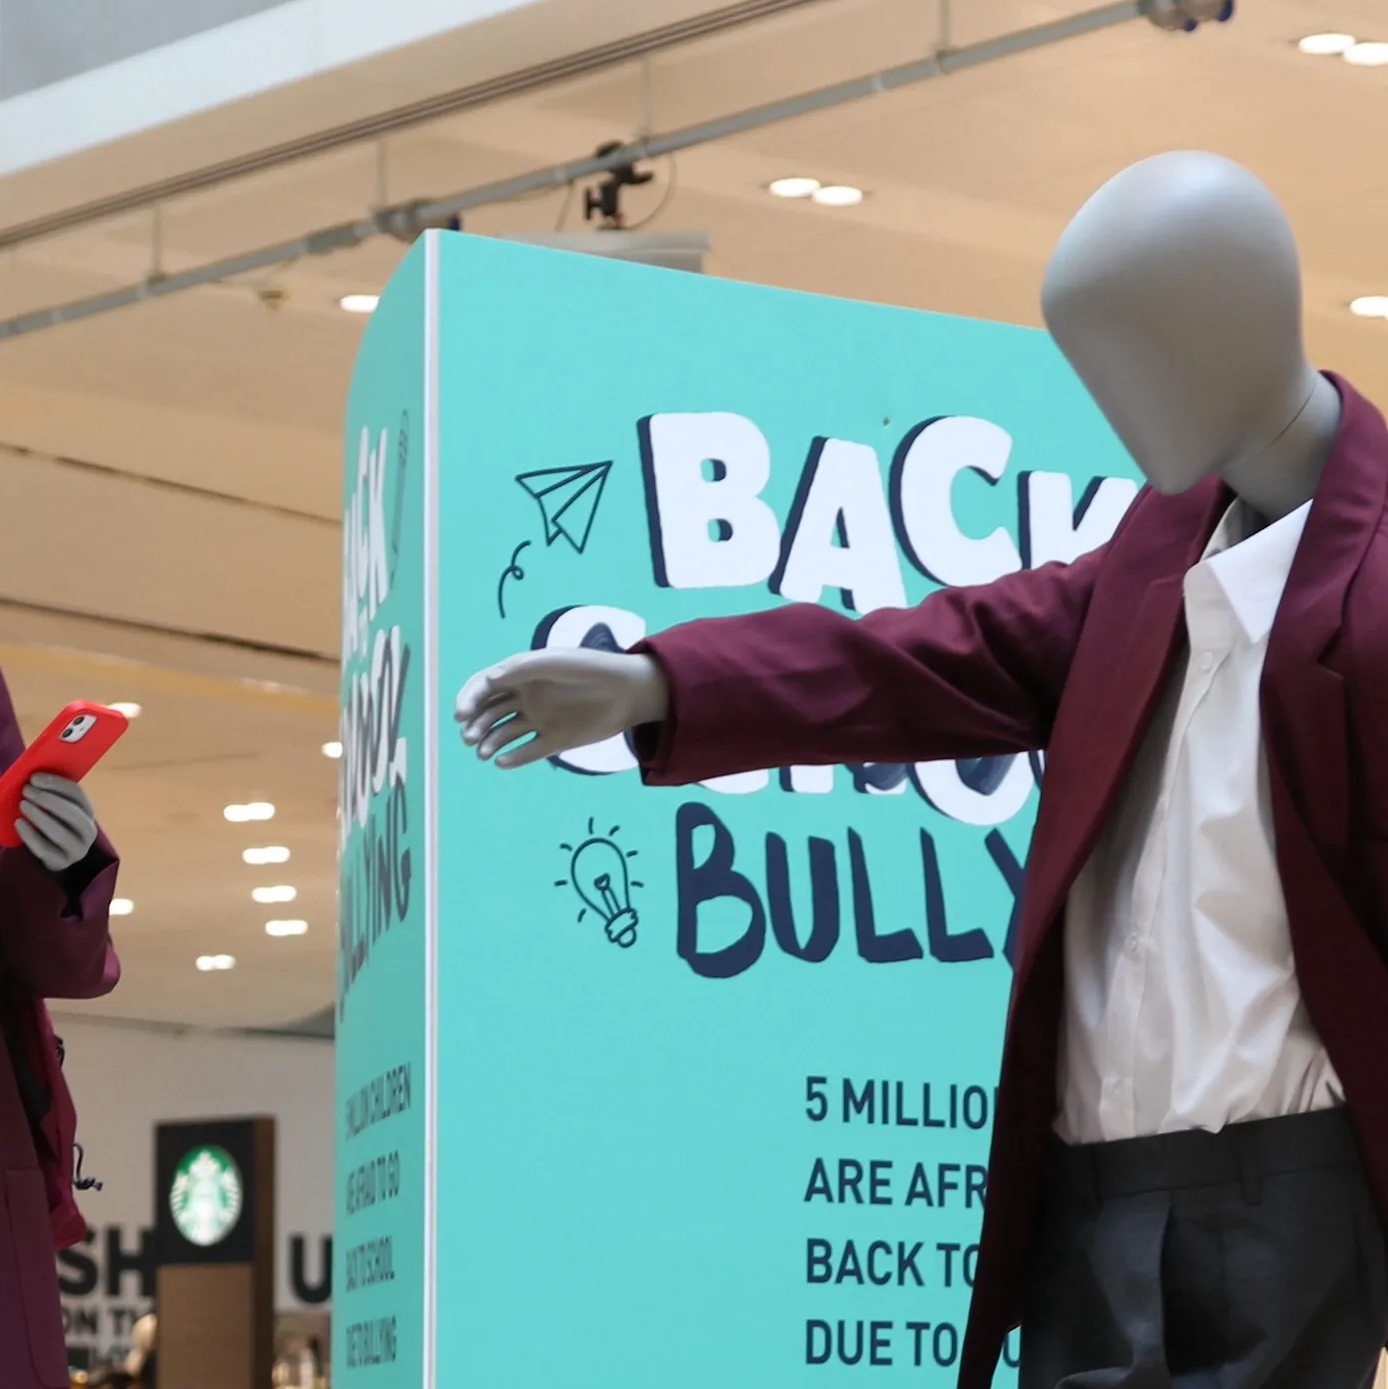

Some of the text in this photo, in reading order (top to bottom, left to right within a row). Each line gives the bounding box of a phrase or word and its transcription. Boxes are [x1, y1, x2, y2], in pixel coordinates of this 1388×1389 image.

[637, 412, 1140, 612] BACK
[806, 1076, 999, 1129] 5 MILLIO
[804, 1157, 893, 1205] ARE
[806, 1238, 925, 1286] BACK
[806, 1319, 893, 1366] DUE
[906, 1322, 958, 1367] TO
